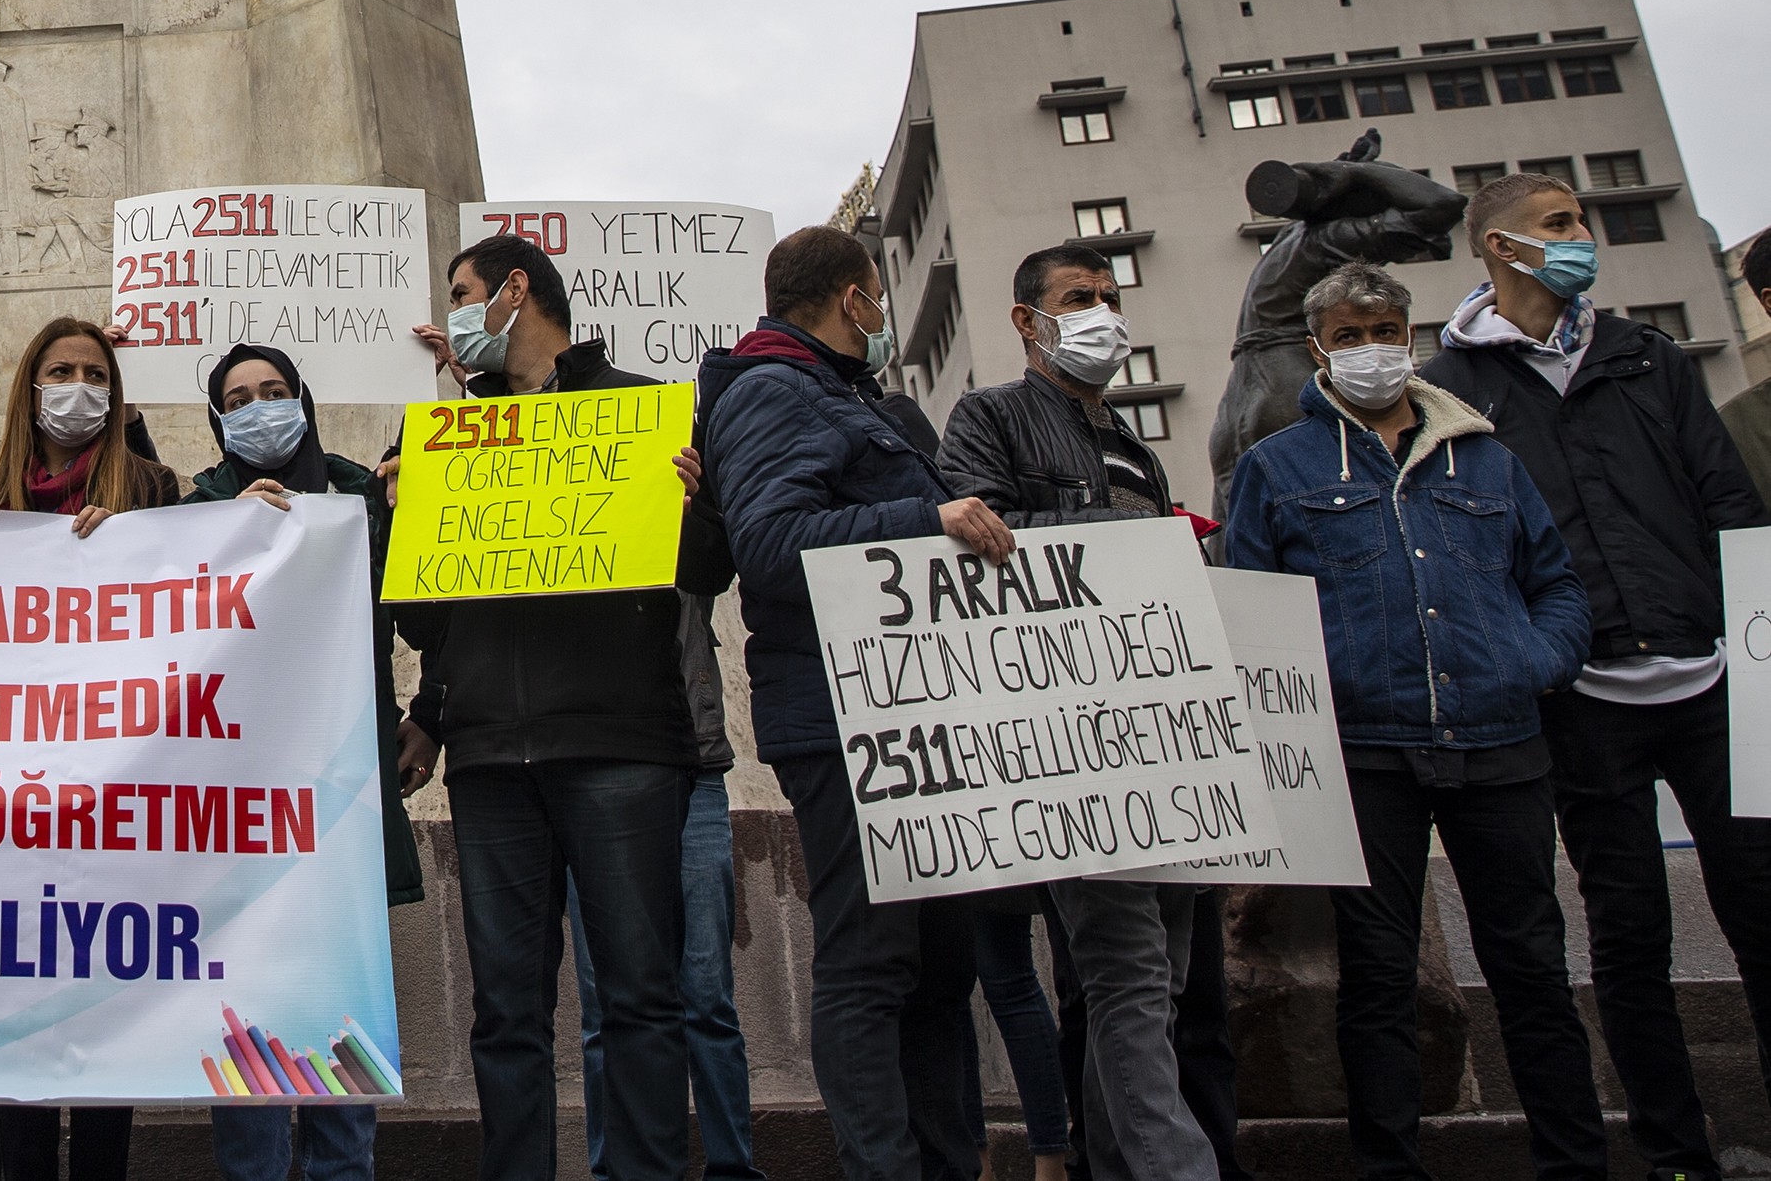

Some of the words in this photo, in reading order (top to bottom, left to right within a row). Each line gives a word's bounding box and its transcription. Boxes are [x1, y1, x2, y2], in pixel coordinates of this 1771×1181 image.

[116, 203, 190, 245] YOLA
[192, 194, 278, 238] 2511
[285, 196, 320, 236] İLE
[327, 200, 413, 239] ÇIKTIK
[591, 212, 748, 254] YETMEZ
[116, 249, 199, 294] 2511
[204, 247, 241, 288] İLE
[568, 268, 687, 307] ARALIK
[229, 301, 263, 344] DE
[269, 305, 394, 344] ALMAYA
[424, 403, 524, 452] 2511
[532, 390, 661, 442] ENGELLİ
[445, 441, 634, 492] ÖĞRETMENE
[437, 492, 614, 544] ENGELSİZ
[415, 543, 617, 595] KONTENJAN
[865, 547, 914, 626] 3
[928, 543, 1102, 624] ARALIK
[827, 630, 982, 716] HÜZÜN
[990, 618, 1098, 692] GÜNÜ
[1100, 601, 1213, 682] DEĞİL
[1234, 665, 1318, 714] MENİN
[845, 722, 968, 805] 2511
[954, 706, 1078, 789] ENGELLİ
[1075, 696, 1251, 773] ÖĞRETMENE
[866, 805, 1013, 886] MÜJDE
[1011, 793, 1118, 860] GÜNÜ
[1124, 781, 1247, 850] OLSUN
